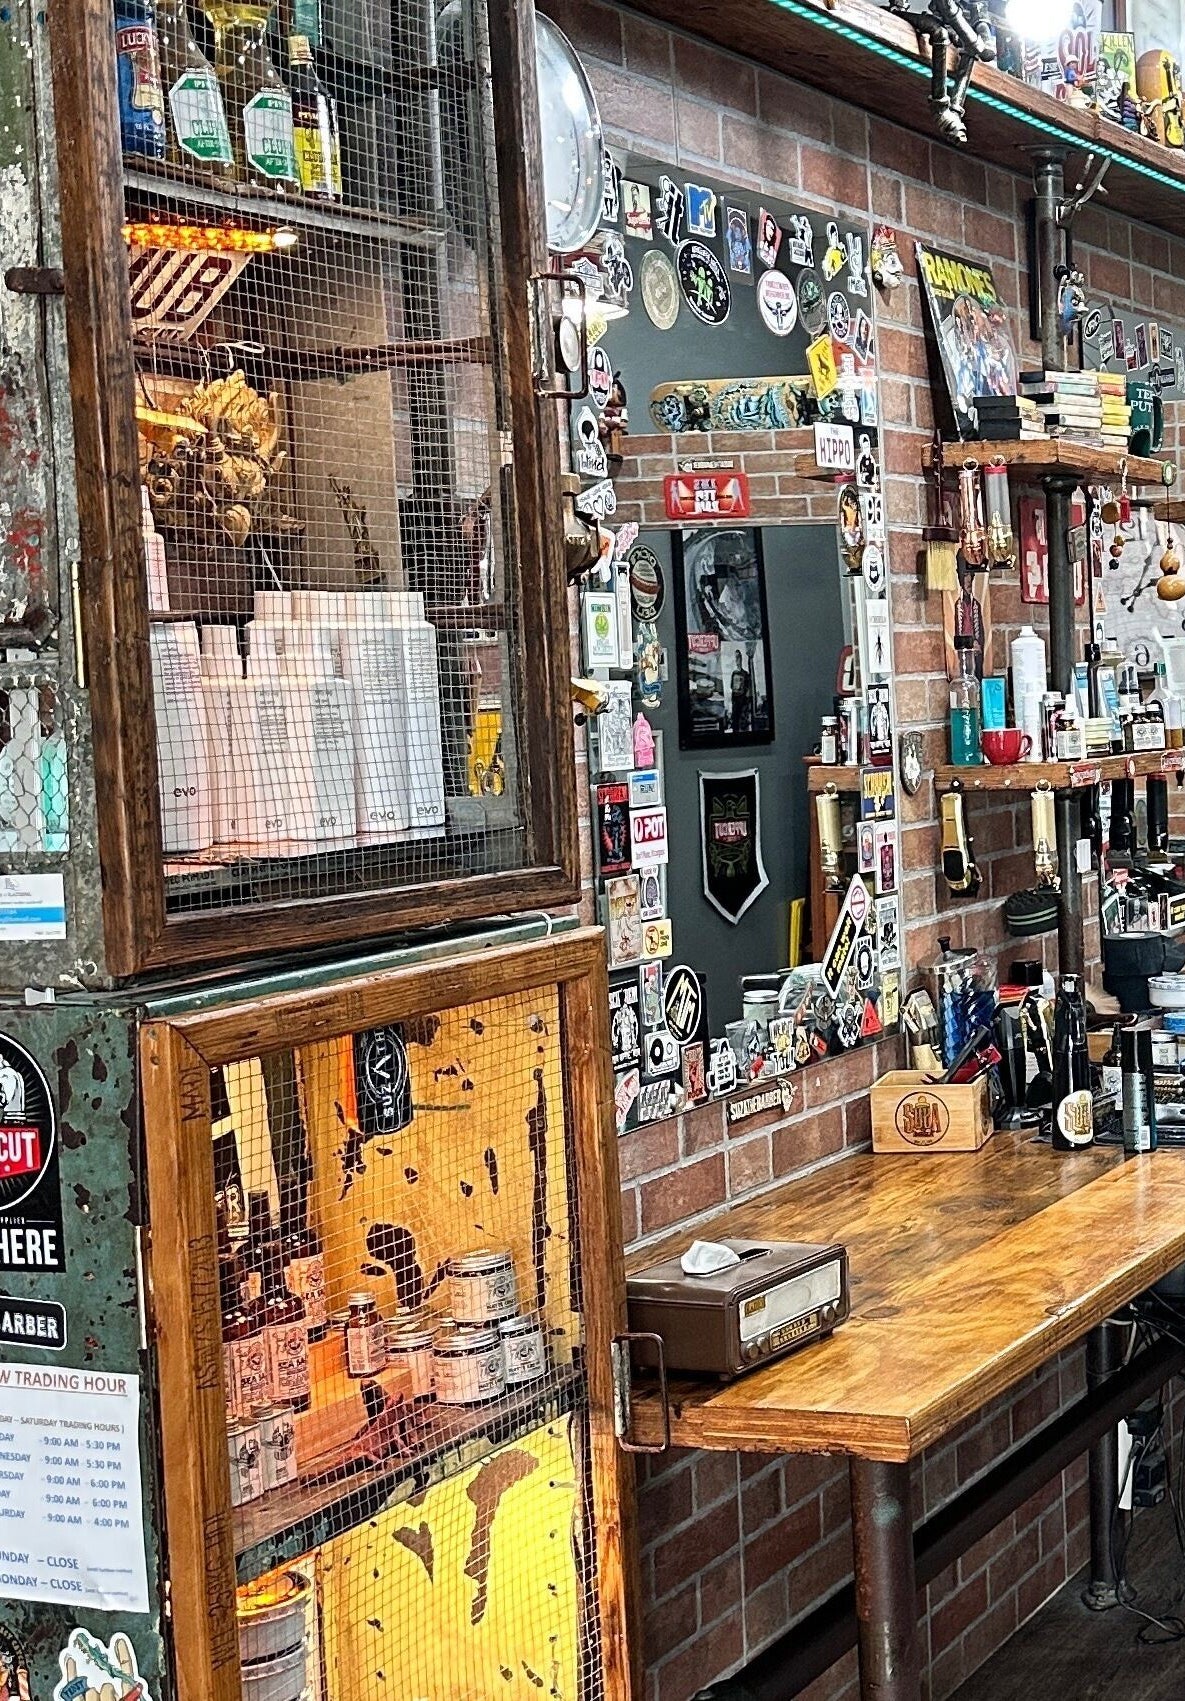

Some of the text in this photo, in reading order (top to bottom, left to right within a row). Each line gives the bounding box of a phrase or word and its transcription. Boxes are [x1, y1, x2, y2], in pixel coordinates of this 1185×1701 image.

[923, 252, 997, 302] RAMONES
[819, 437, 851, 465] HIPPO
[173, 786, 196, 798] evo
[370, 810, 395, 820] evo
[417, 805, 439, 816] evo
[265, 818, 283, 829] evo
[320, 816, 337, 827] evo
[0, 1131, 36, 1168] CUT
[0, 1229, 58, 1265] HERE
[15, 1371, 79, 1390] TRADING
[84, 1375, 127, 1393] HOUR
[20, 1417, 57, 1427] SATURDAY
[59, 1419, 92, 1430] TRADING
[94, 1423, 120, 1432] HOURS
[43, 1436, 62, 1446] 9:00
[64, 1439, 79, 1448] AM
[86, 1440, 104, 1450] 5:30
[106, 1442, 121, 1451] PM
[45, 1455, 62, 1465] 9:00
[64, 1458, 79, 1467] AM
[86, 1459, 105, 1469] 5:30
[107, 1461, 121, 1470] PM
[46, 1475, 65, 1485] 9:00
[66, 1477, 81, 1486] AM
[90, 1479, 109, 1488] 6:00
[111, 1481, 126, 1490] PM
[45, 1494, 64, 1504] 9:00
[66, 1496, 81, 1505] AM
[92, 1498, 111, 1508] 6:00
[113, 1500, 128, 1509] PM
[47, 1513, 65, 1523] 9:00
[67, 1515, 82, 1524] AM
[94, 1517, 113, 1527] 4:00
[115, 1519, 130, 1528] PM
[47, 1556, 79, 1570] CLOSE
[0, 1574, 38, 1587] ONDAY
[50, 1579, 82, 1592] CLOSE
